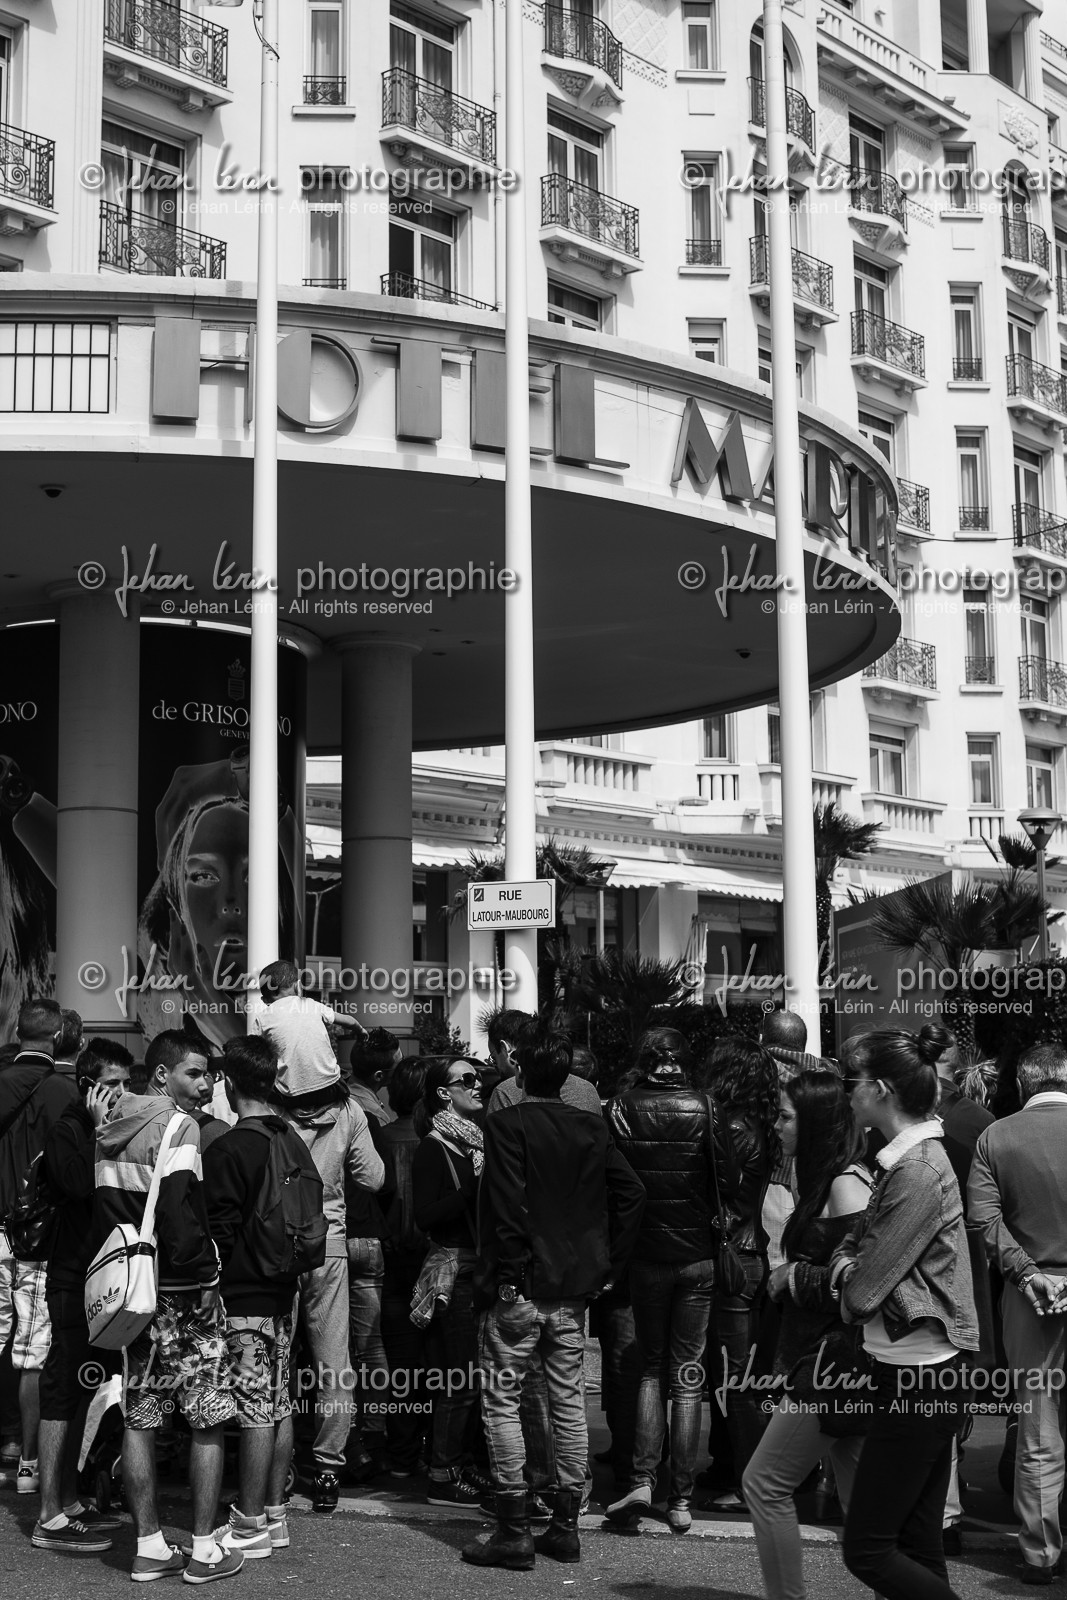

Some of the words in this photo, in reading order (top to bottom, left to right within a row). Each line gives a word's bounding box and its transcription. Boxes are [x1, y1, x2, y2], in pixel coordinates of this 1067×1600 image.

[151, 317, 630, 470] HOTEL
[152, 700, 177, 720] de
[183, 701, 291, 737] GRISONO
[499, 889, 522, 901] RUE
[472, 908, 549, 922] LATOUR-MAUBOURG
